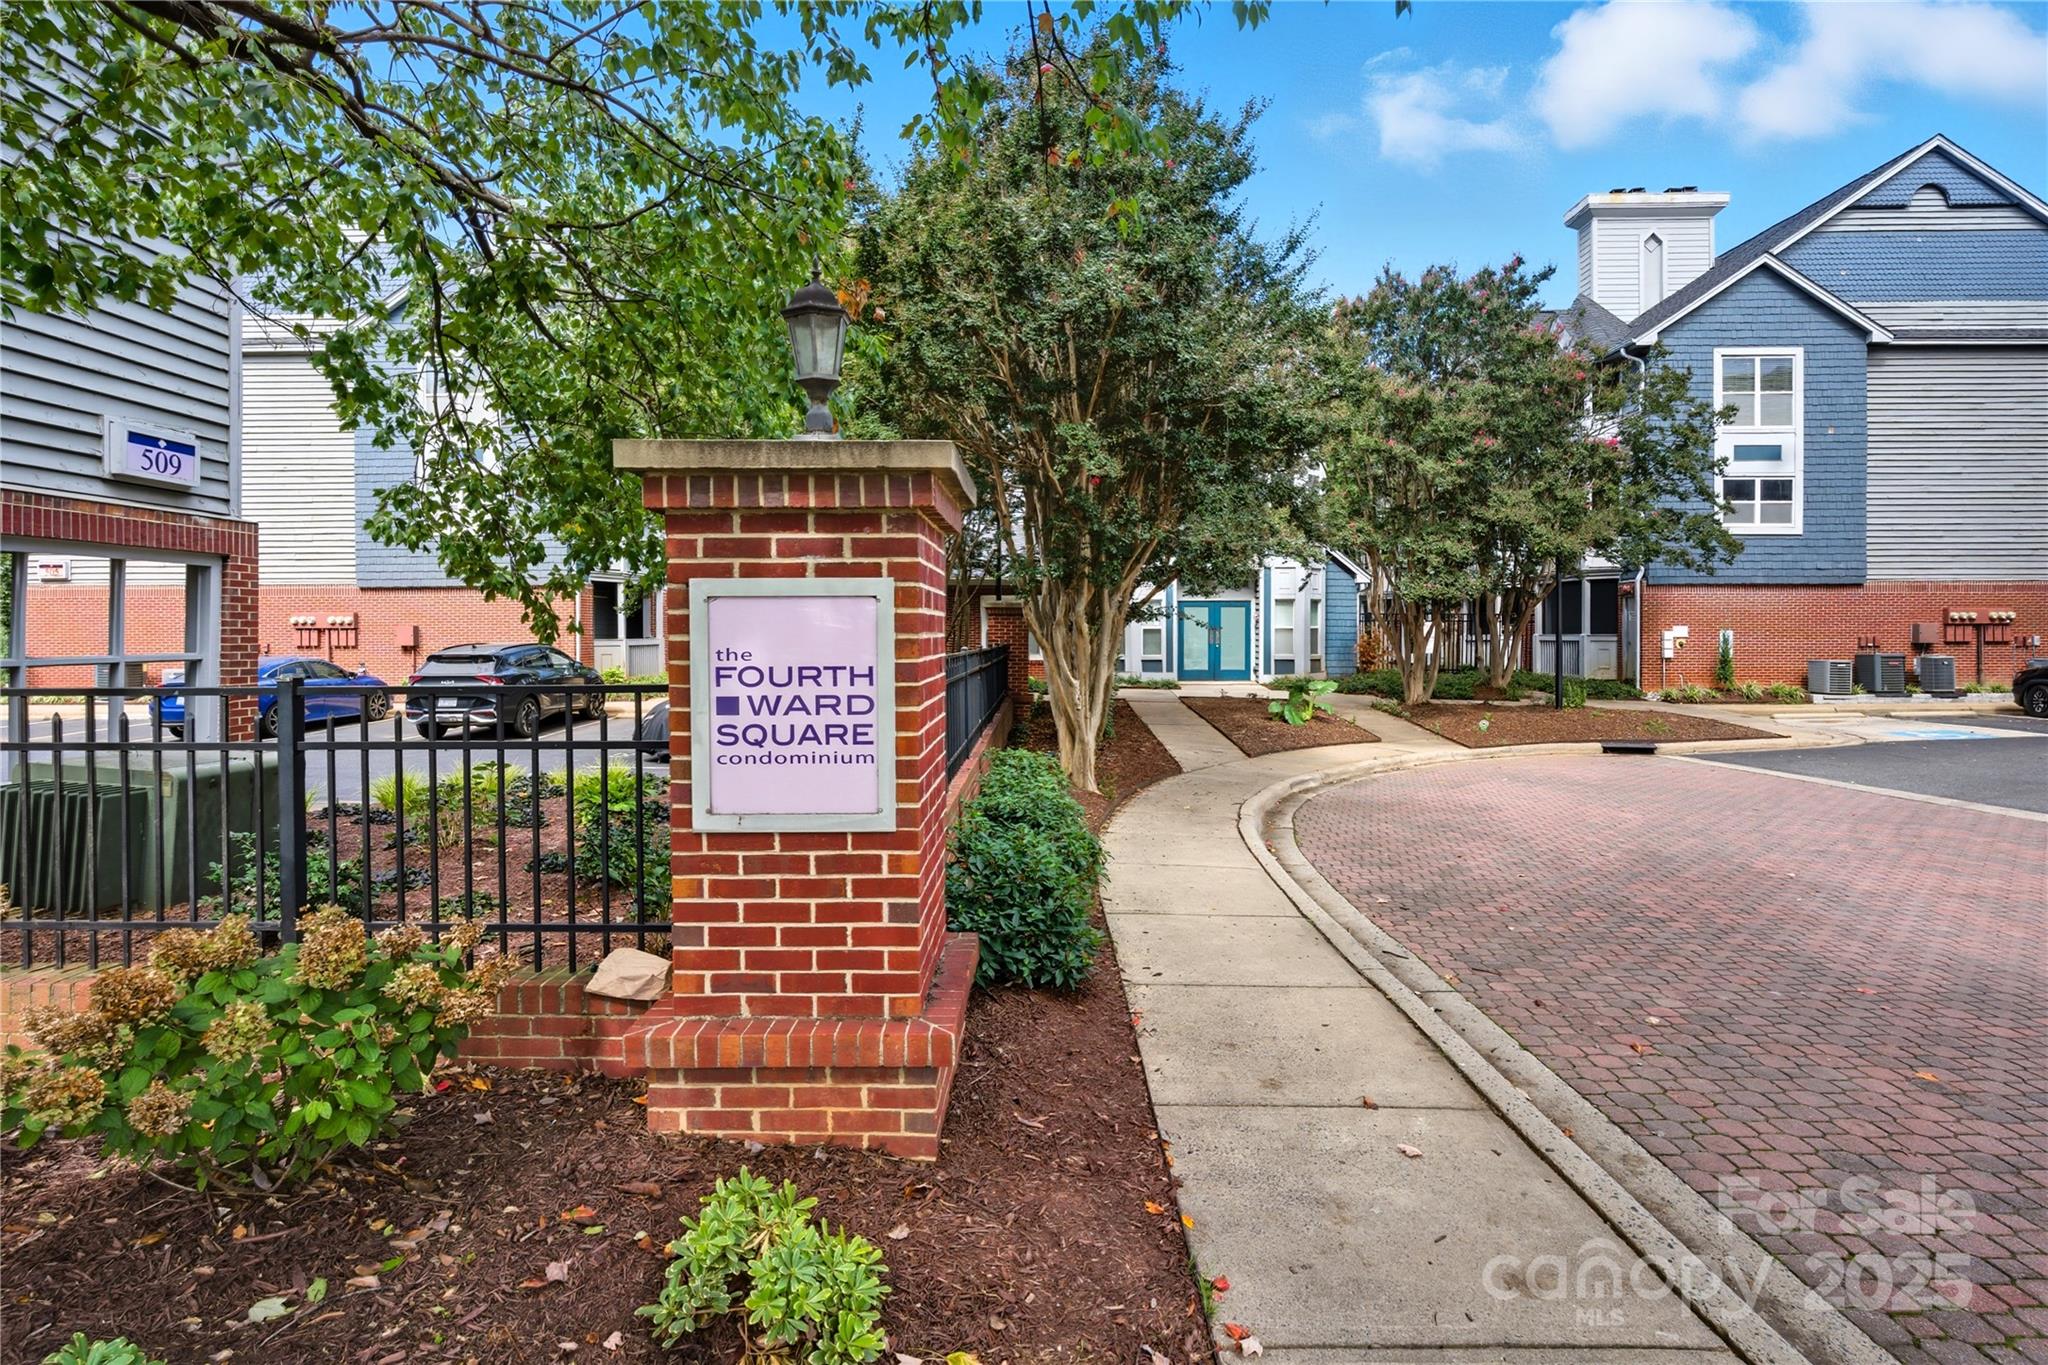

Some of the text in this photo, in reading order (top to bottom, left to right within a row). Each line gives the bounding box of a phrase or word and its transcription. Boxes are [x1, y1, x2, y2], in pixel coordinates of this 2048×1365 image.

[141, 448, 182, 475] 509
[716, 647, 753, 662] the
[715, 666, 874, 687] FOURTH
[747, 694, 875, 716] WARD
[716, 723, 874, 748] SQUARE
[717, 751, 875, 765] condominium
